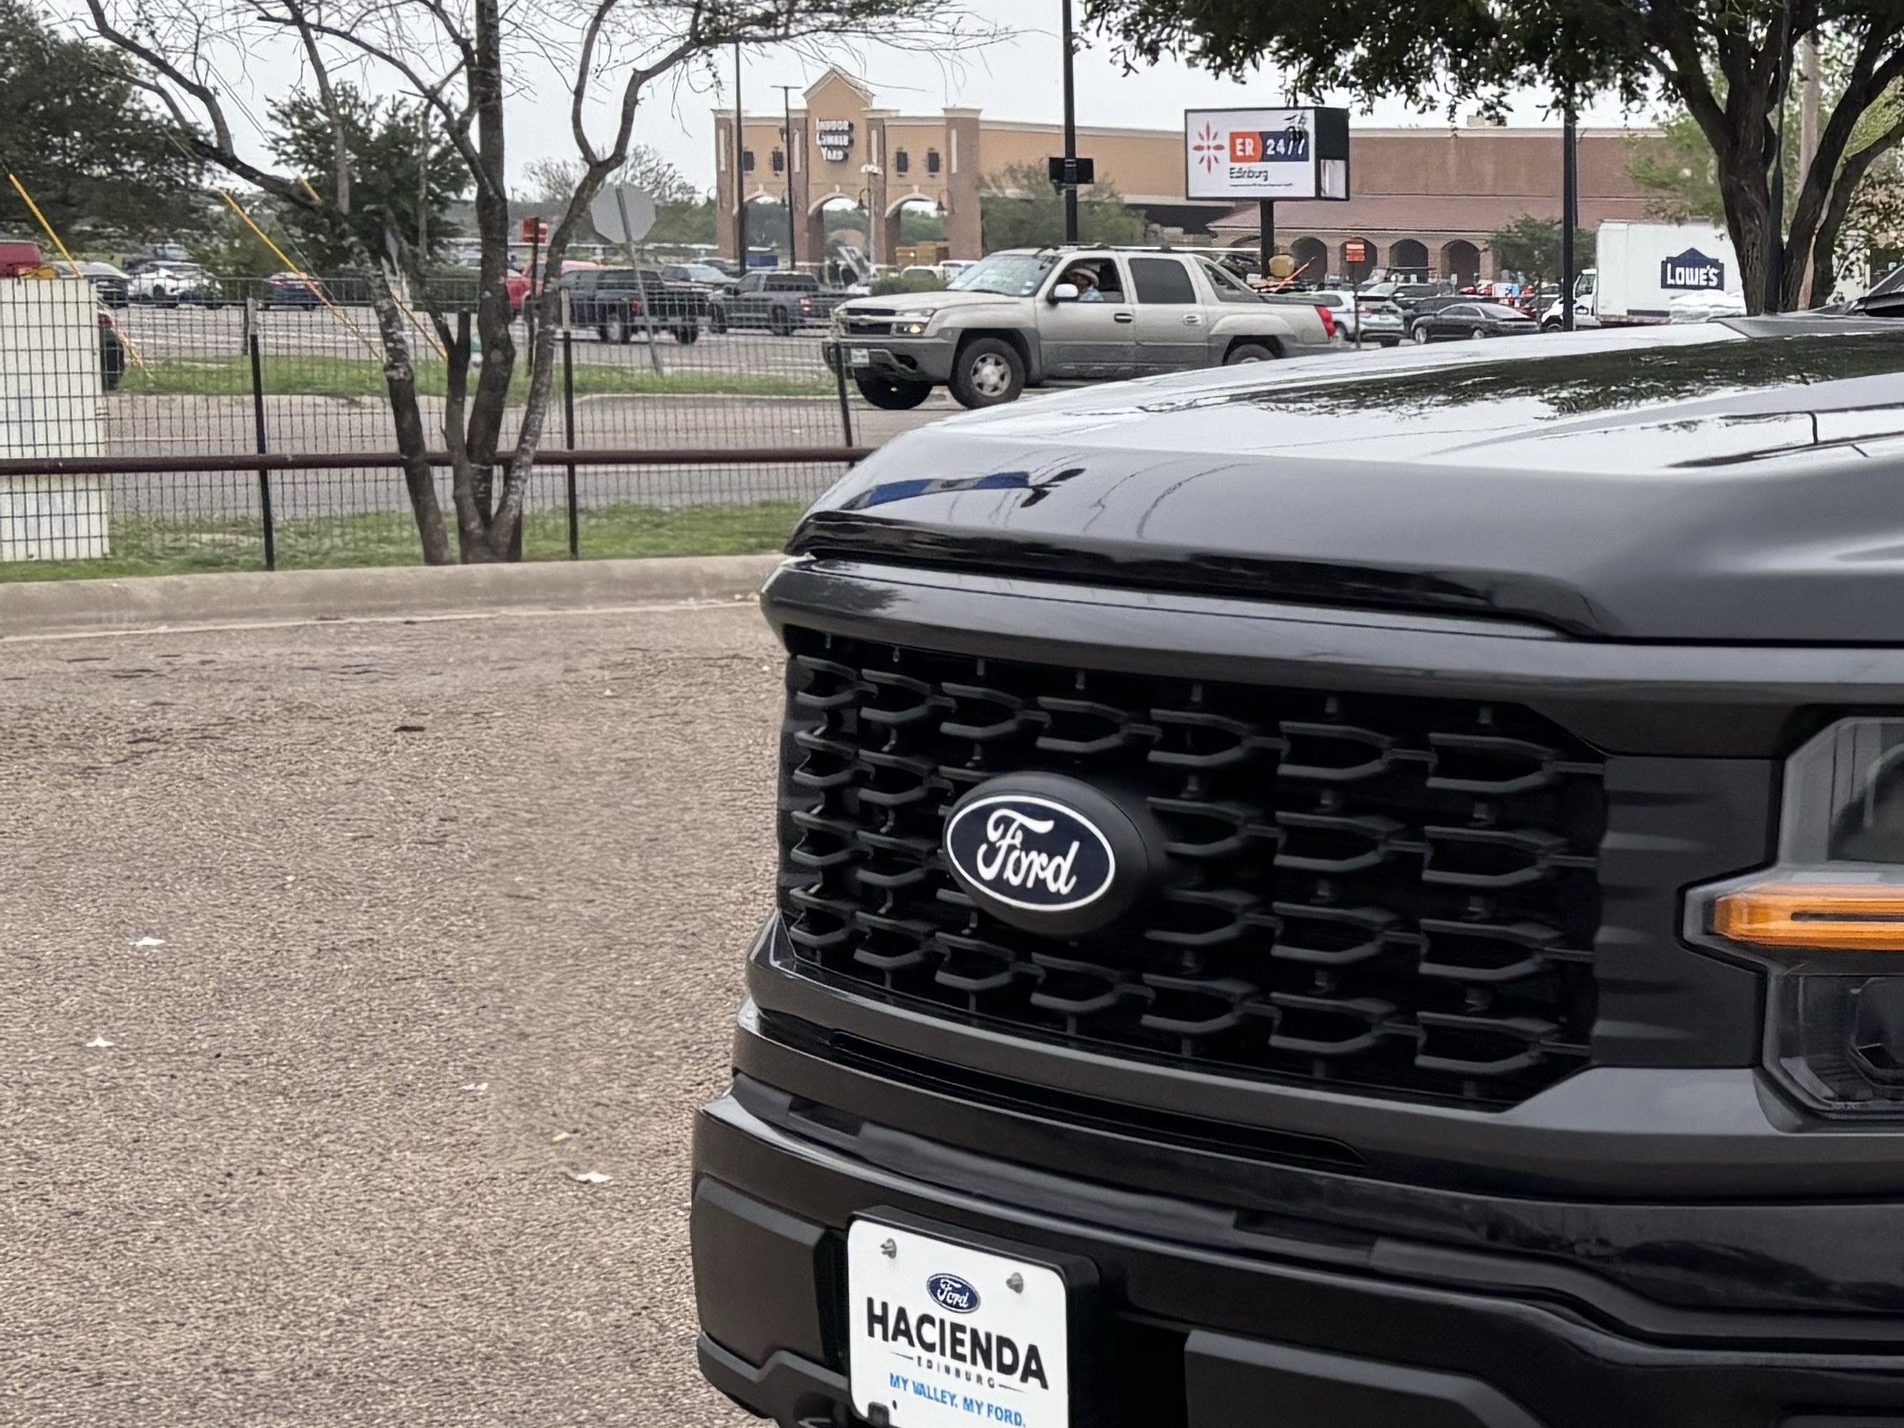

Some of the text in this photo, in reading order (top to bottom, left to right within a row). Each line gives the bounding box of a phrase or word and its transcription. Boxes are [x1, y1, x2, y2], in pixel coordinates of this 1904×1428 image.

[1235, 138, 1254, 156] ER
[1666, 262, 1720, 287] LOWE'S
[976, 808, 1080, 895] Ford
[937, 1278, 970, 1308] Ford
[866, 1296, 1049, 1390] HACIENDA
[917, 1355, 995, 1389] EDINBURG
[889, 1373, 1026, 1428] MY VALLEY. MY FORD.
